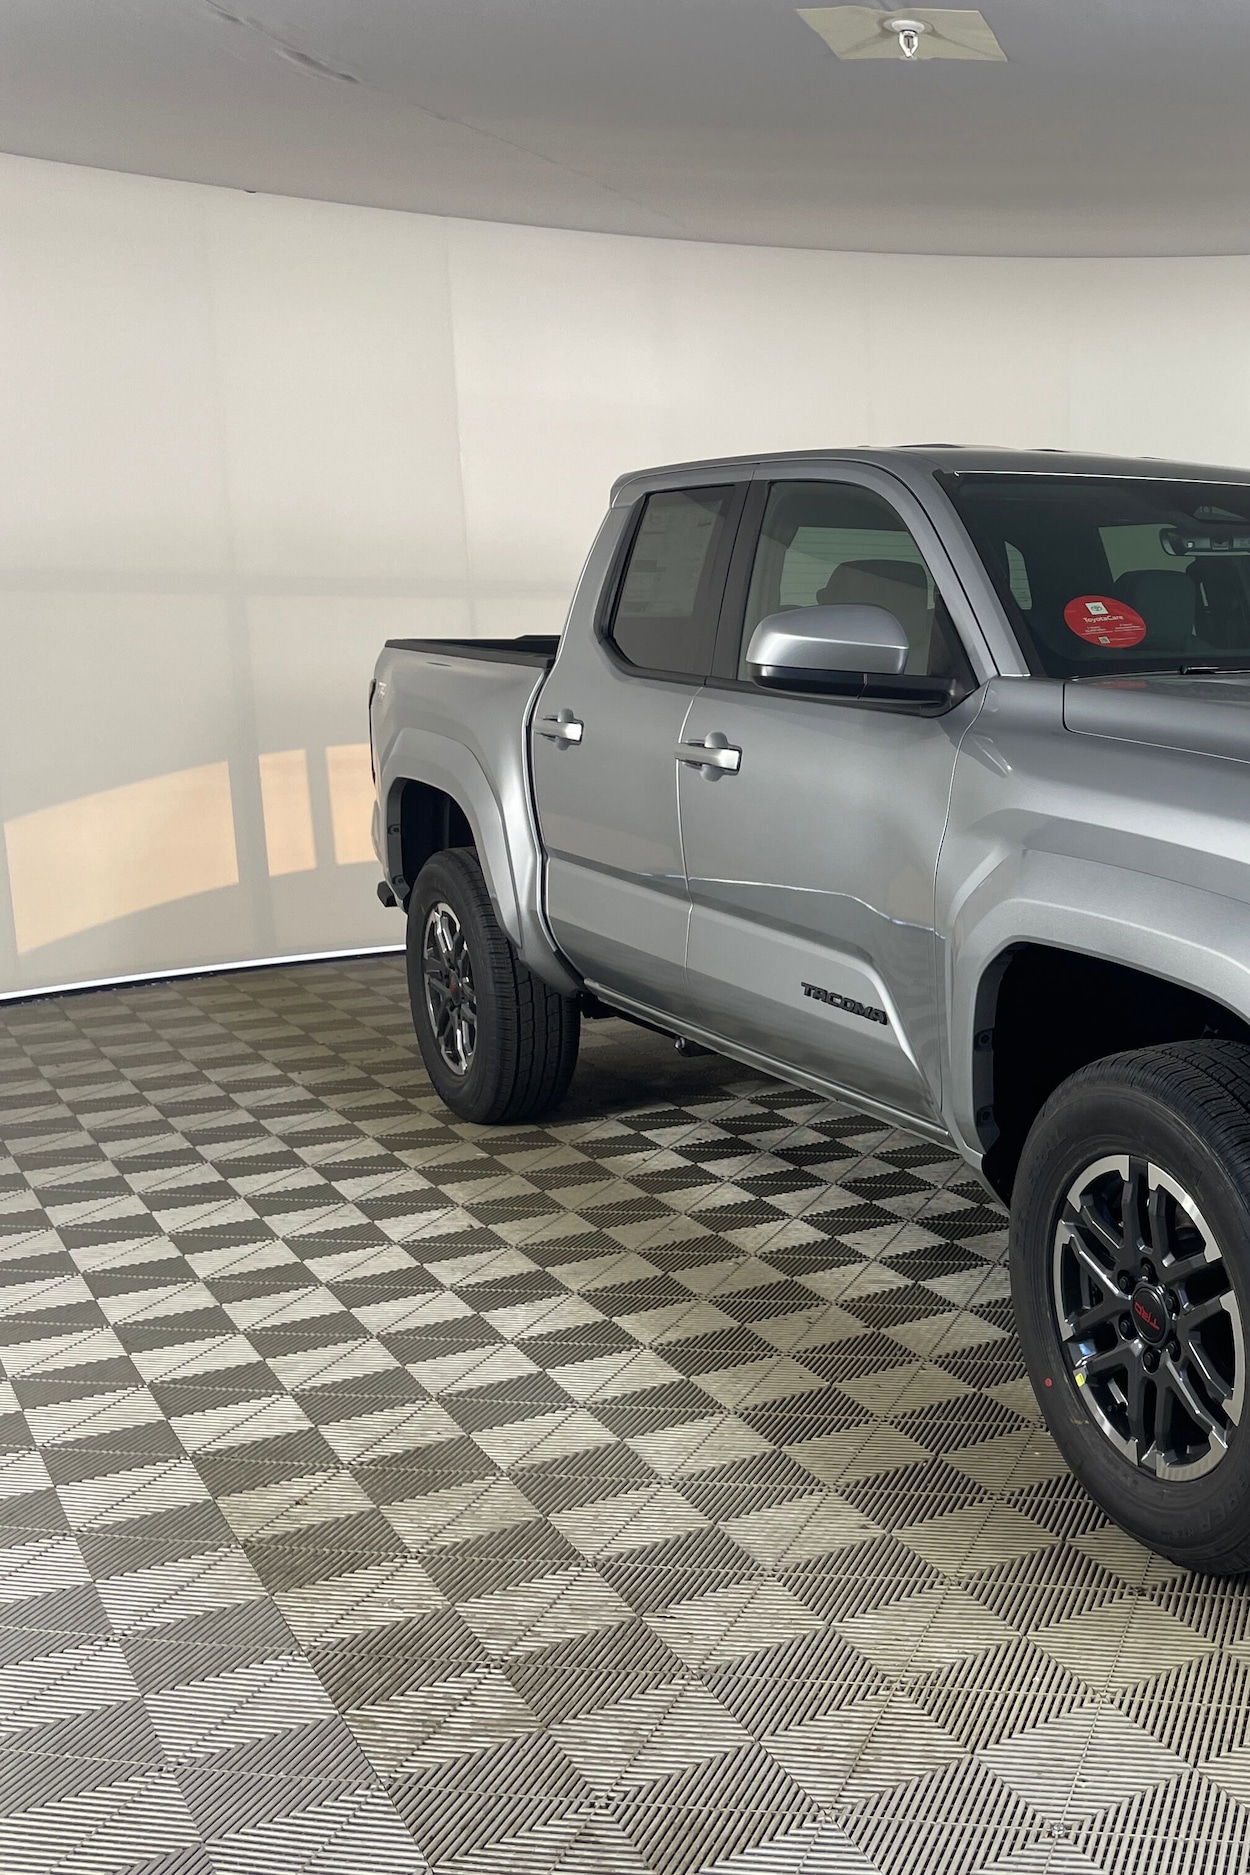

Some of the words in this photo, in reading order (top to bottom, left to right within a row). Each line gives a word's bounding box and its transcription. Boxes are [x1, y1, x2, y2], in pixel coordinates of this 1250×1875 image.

[1083, 615, 1124, 623] ToyotaCare
[801, 981, 888, 1026] TACOMA
[1134, 1301, 1160, 1330] TRD
